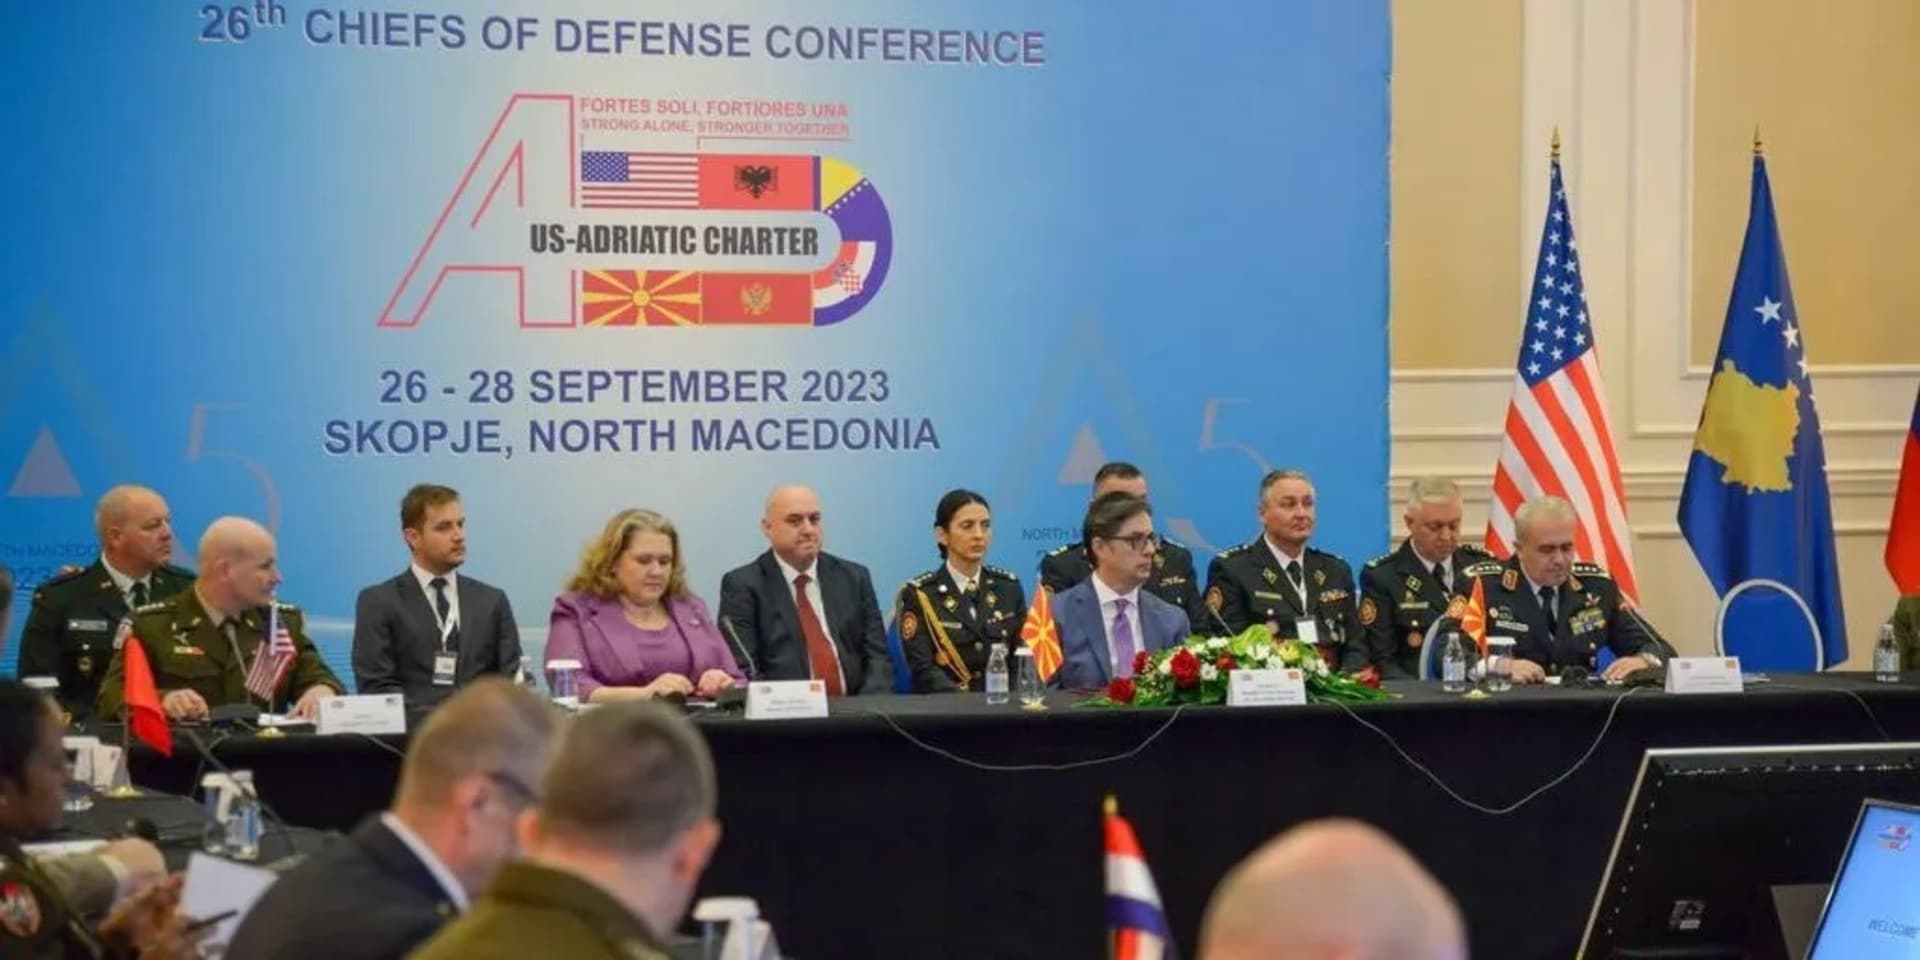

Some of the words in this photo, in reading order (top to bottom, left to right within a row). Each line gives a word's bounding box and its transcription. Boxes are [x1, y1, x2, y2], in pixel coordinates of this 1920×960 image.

[304, 9, 466, 49] CHIEFS
[481, 16, 539, 51] OF
[555, 18, 751, 57] DEFENSE
[765, 25, 1046, 64] CONFERENCE
[580, 97, 650, 114] FORTES
[707, 99, 806, 118] FORTIORES
[812, 102, 850, 118] UNA
[581, 118, 640, 131] STRONG
[643, 118, 694, 133] ALONE,
[698, 120, 771, 135] STRONGER
[775, 121, 850, 137] TOGETHER
[530, 223, 697, 255] US-ADRIATIC
[703, 225, 819, 256] CHARTER
[379, 369, 428, 404] 26
[442, 386, 456, 395] -
[467, 369, 515, 404] 28
[529, 369, 789, 404] SEPTEMBER
[801, 369, 890, 403] 2023
[324, 419, 514, 460] SKOPJE,
[529, 418, 677, 454] NORTH
[691, 417, 941, 452] MACEDONIA
[1022, 527, 1069, 541] NORTH
